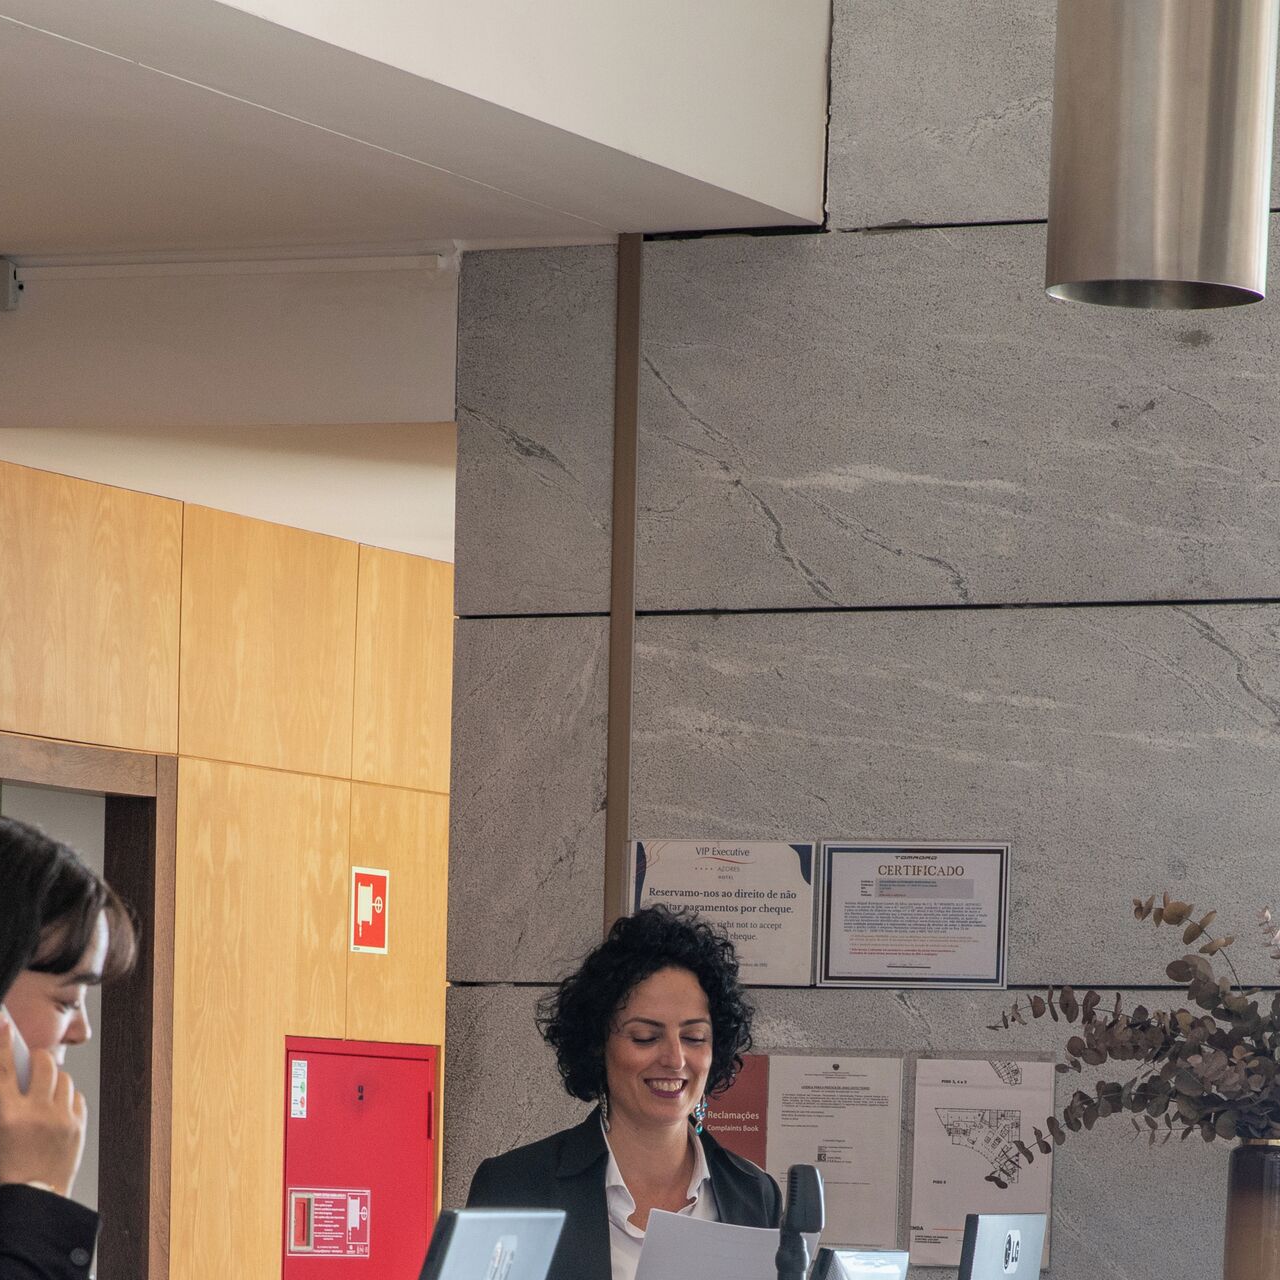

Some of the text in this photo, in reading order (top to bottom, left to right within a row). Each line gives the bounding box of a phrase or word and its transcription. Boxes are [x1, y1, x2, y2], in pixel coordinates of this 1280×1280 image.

[695, 847, 750, 857] VIP Executive
[878, 865, 965, 876] CERTIFICADO
[649, 887, 720, 898] Reservamo-nos
[734, 889, 765, 899] direito
[767, 889, 778, 899] de
[780, 890, 797, 899] não
[684, 904, 738, 913] pagamentos
[740, 905, 757, 914] por
[758, 904, 794, 915] cheque.
[717, 921, 734, 930] right
[759, 922, 782, 931] accept
[707, 1110, 760, 1121] Reclamações
[707, 1124, 742, 1132] Complaints
